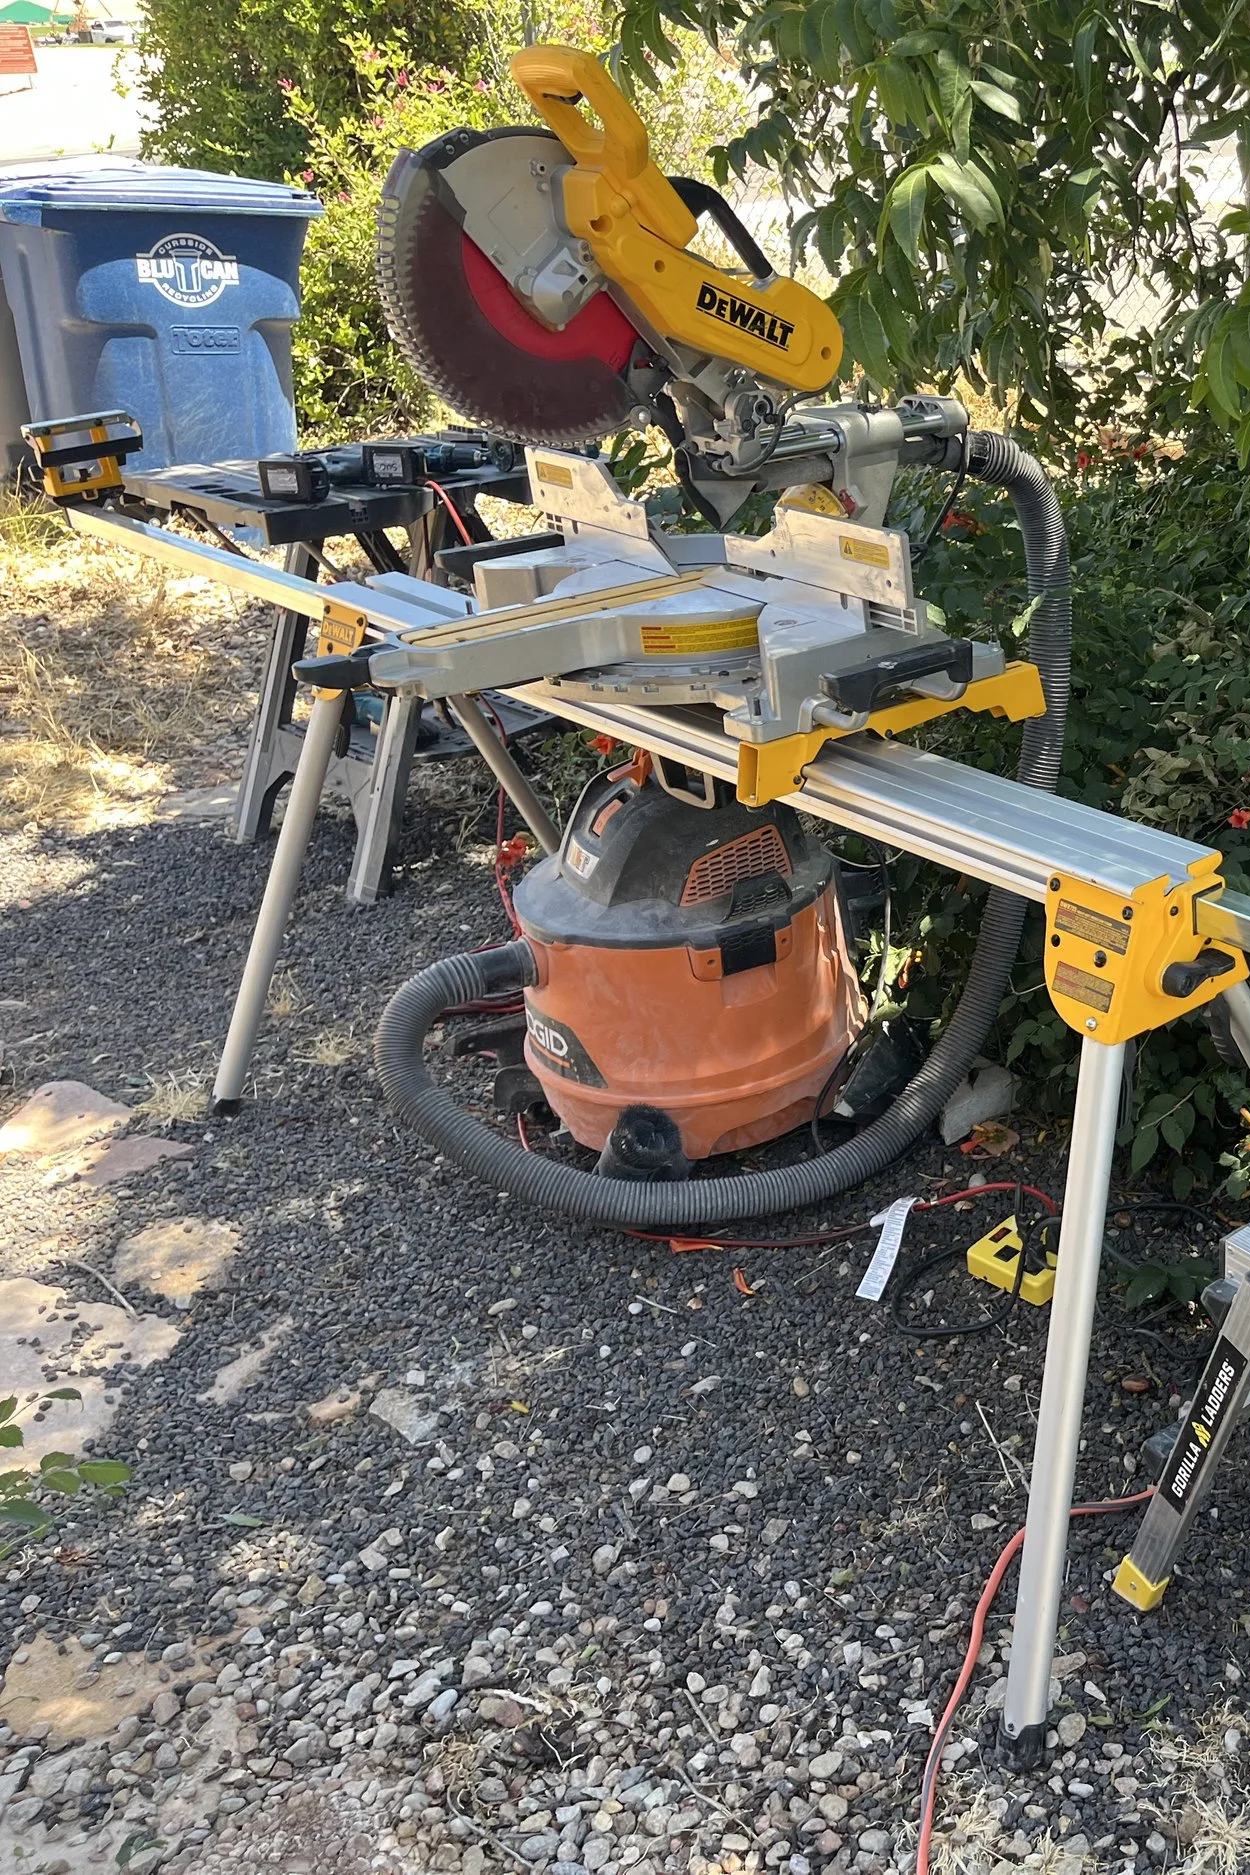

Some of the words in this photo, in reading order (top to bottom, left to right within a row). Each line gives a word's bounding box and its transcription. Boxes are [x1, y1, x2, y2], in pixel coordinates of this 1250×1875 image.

[158, 239, 213, 255] CURBSIDE
[137, 259, 175, 279] BLU
[201, 260, 239, 279] CAN
[161, 282, 218, 303] RECYCLING
[173, 328, 238, 352] Toter
[525, 1007, 568, 1056] DGID
[1172, 1441, 1202, 1498] GORILLA
[1201, 1361, 1235, 1427] LADDERS
